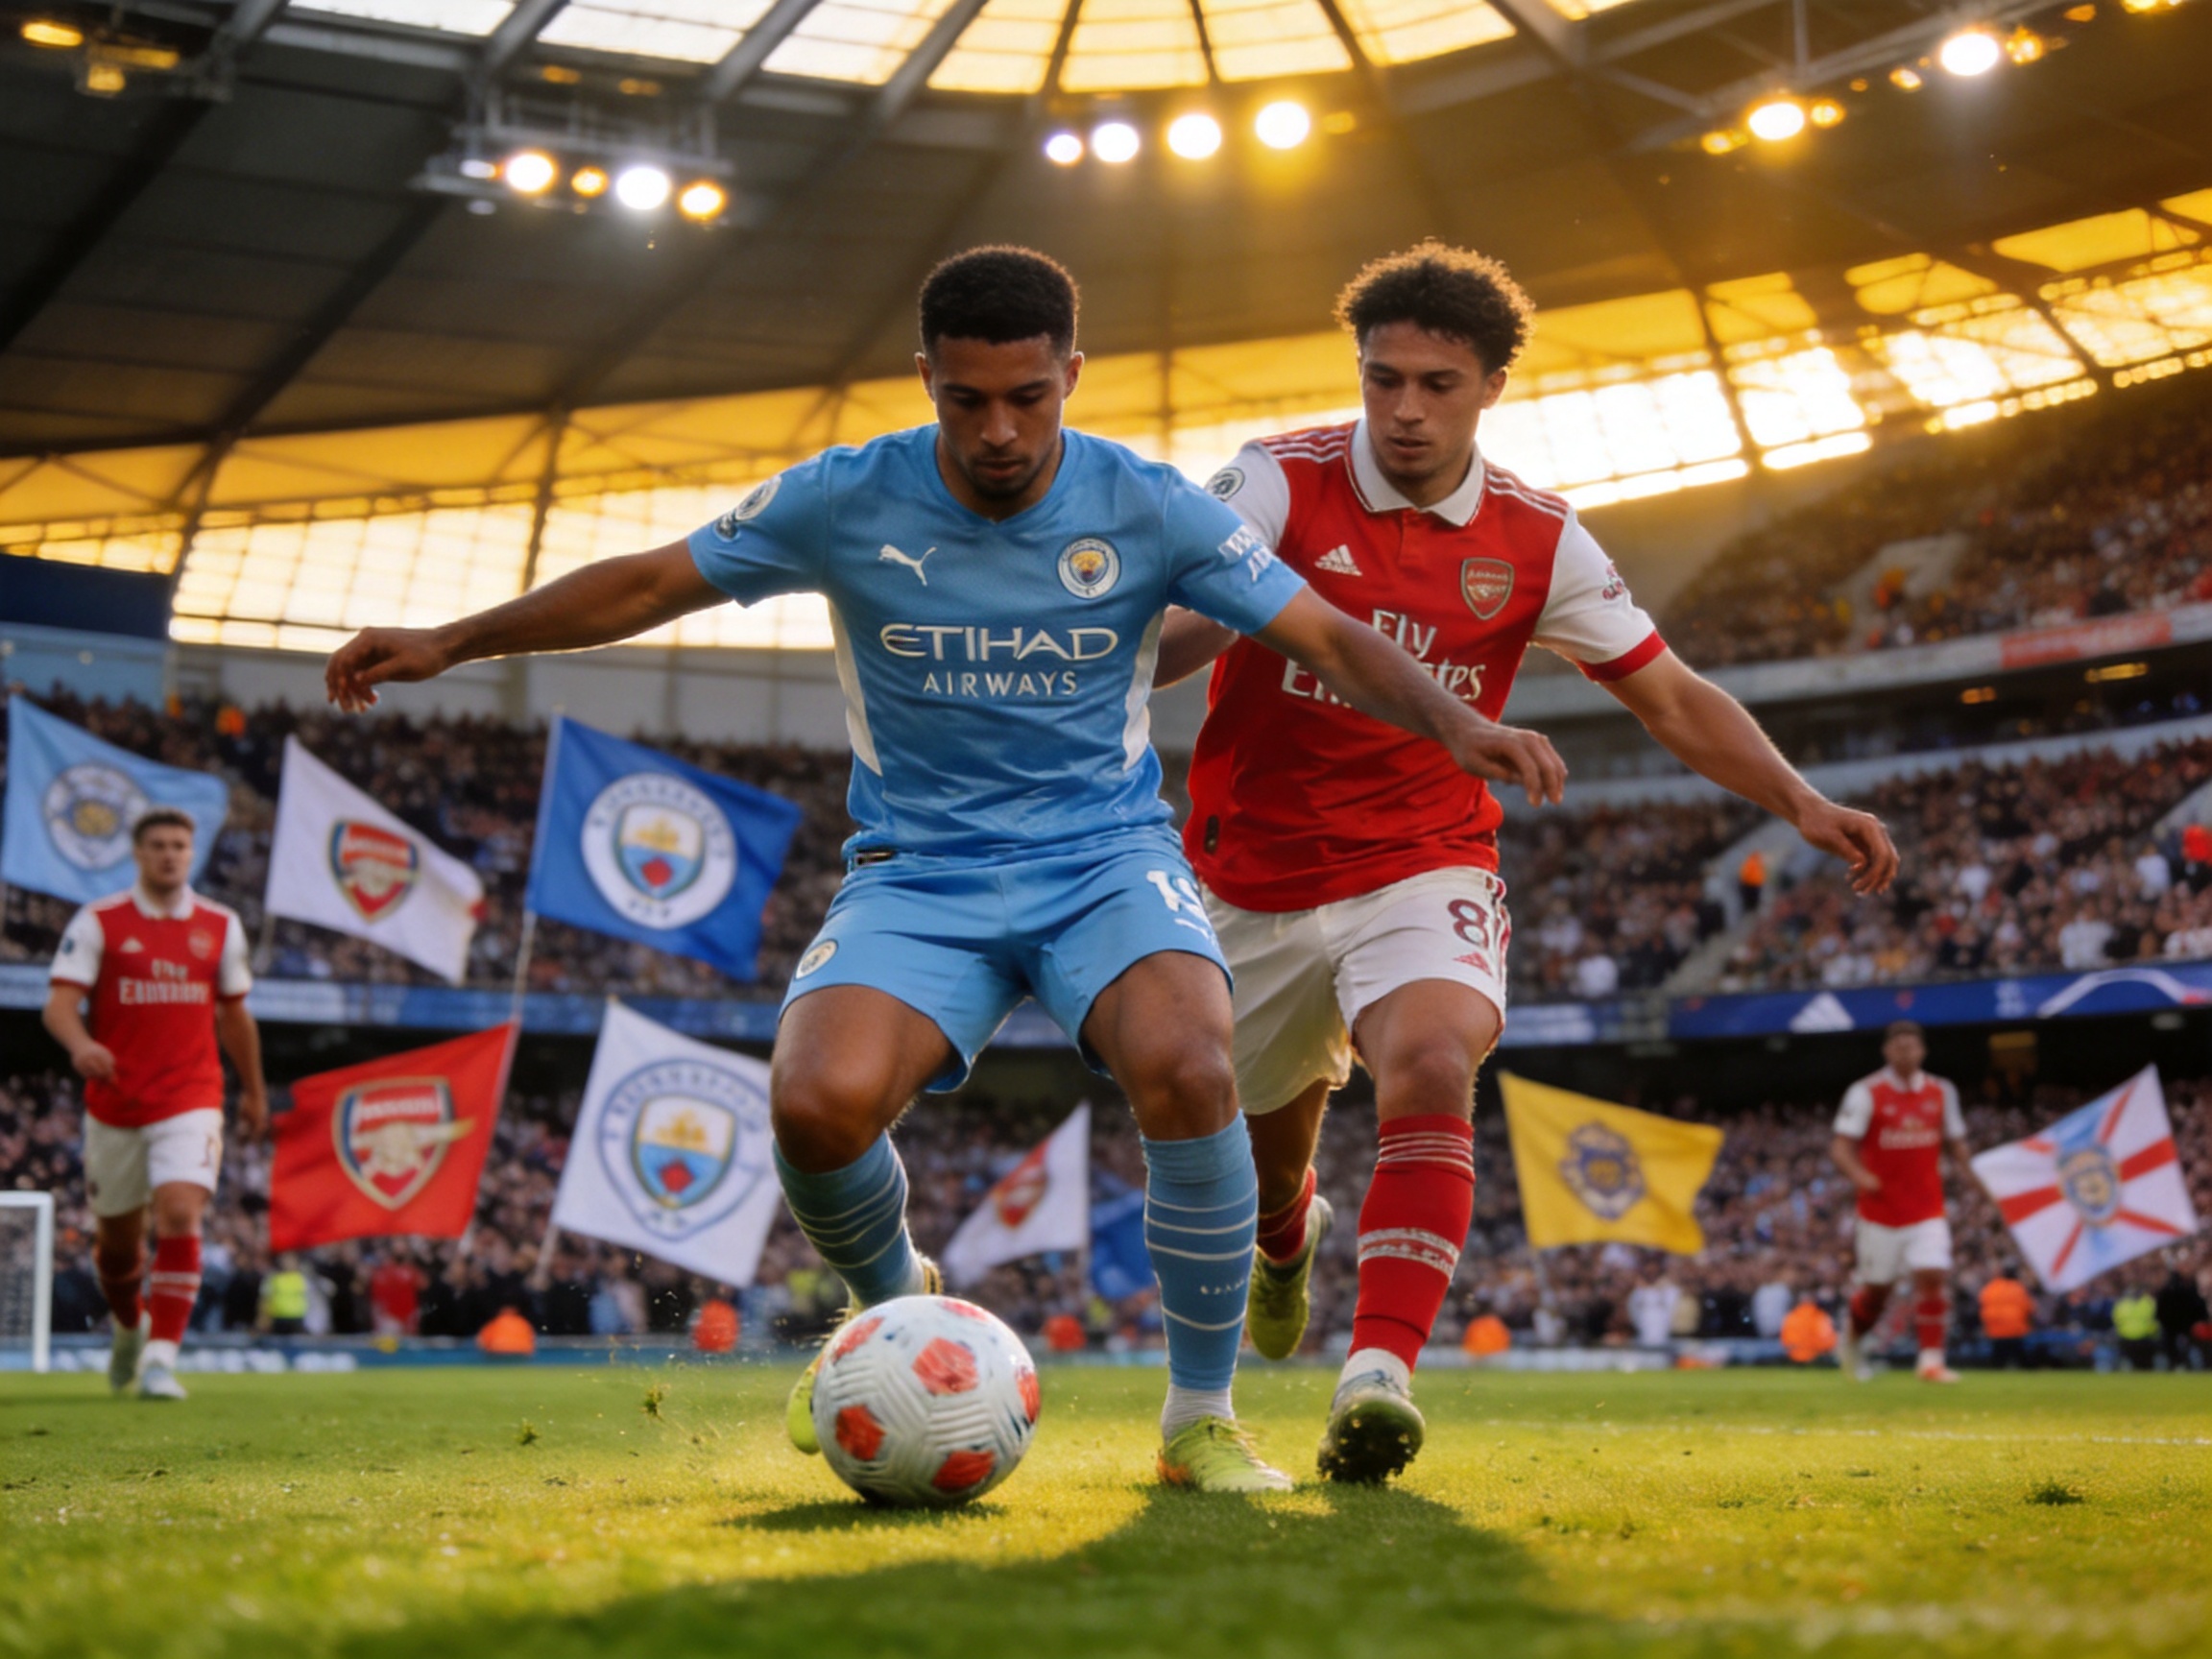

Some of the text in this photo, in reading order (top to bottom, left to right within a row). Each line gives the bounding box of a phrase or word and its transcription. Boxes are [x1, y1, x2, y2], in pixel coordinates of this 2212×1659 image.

[879, 623, 1119, 661] ETIHAD
[1372, 608, 1438, 660] Fly
[922, 670, 1078, 699] AIRWAYS
[1281, 657, 1487, 709] Etes
[1447, 899, 1490, 950] 8
